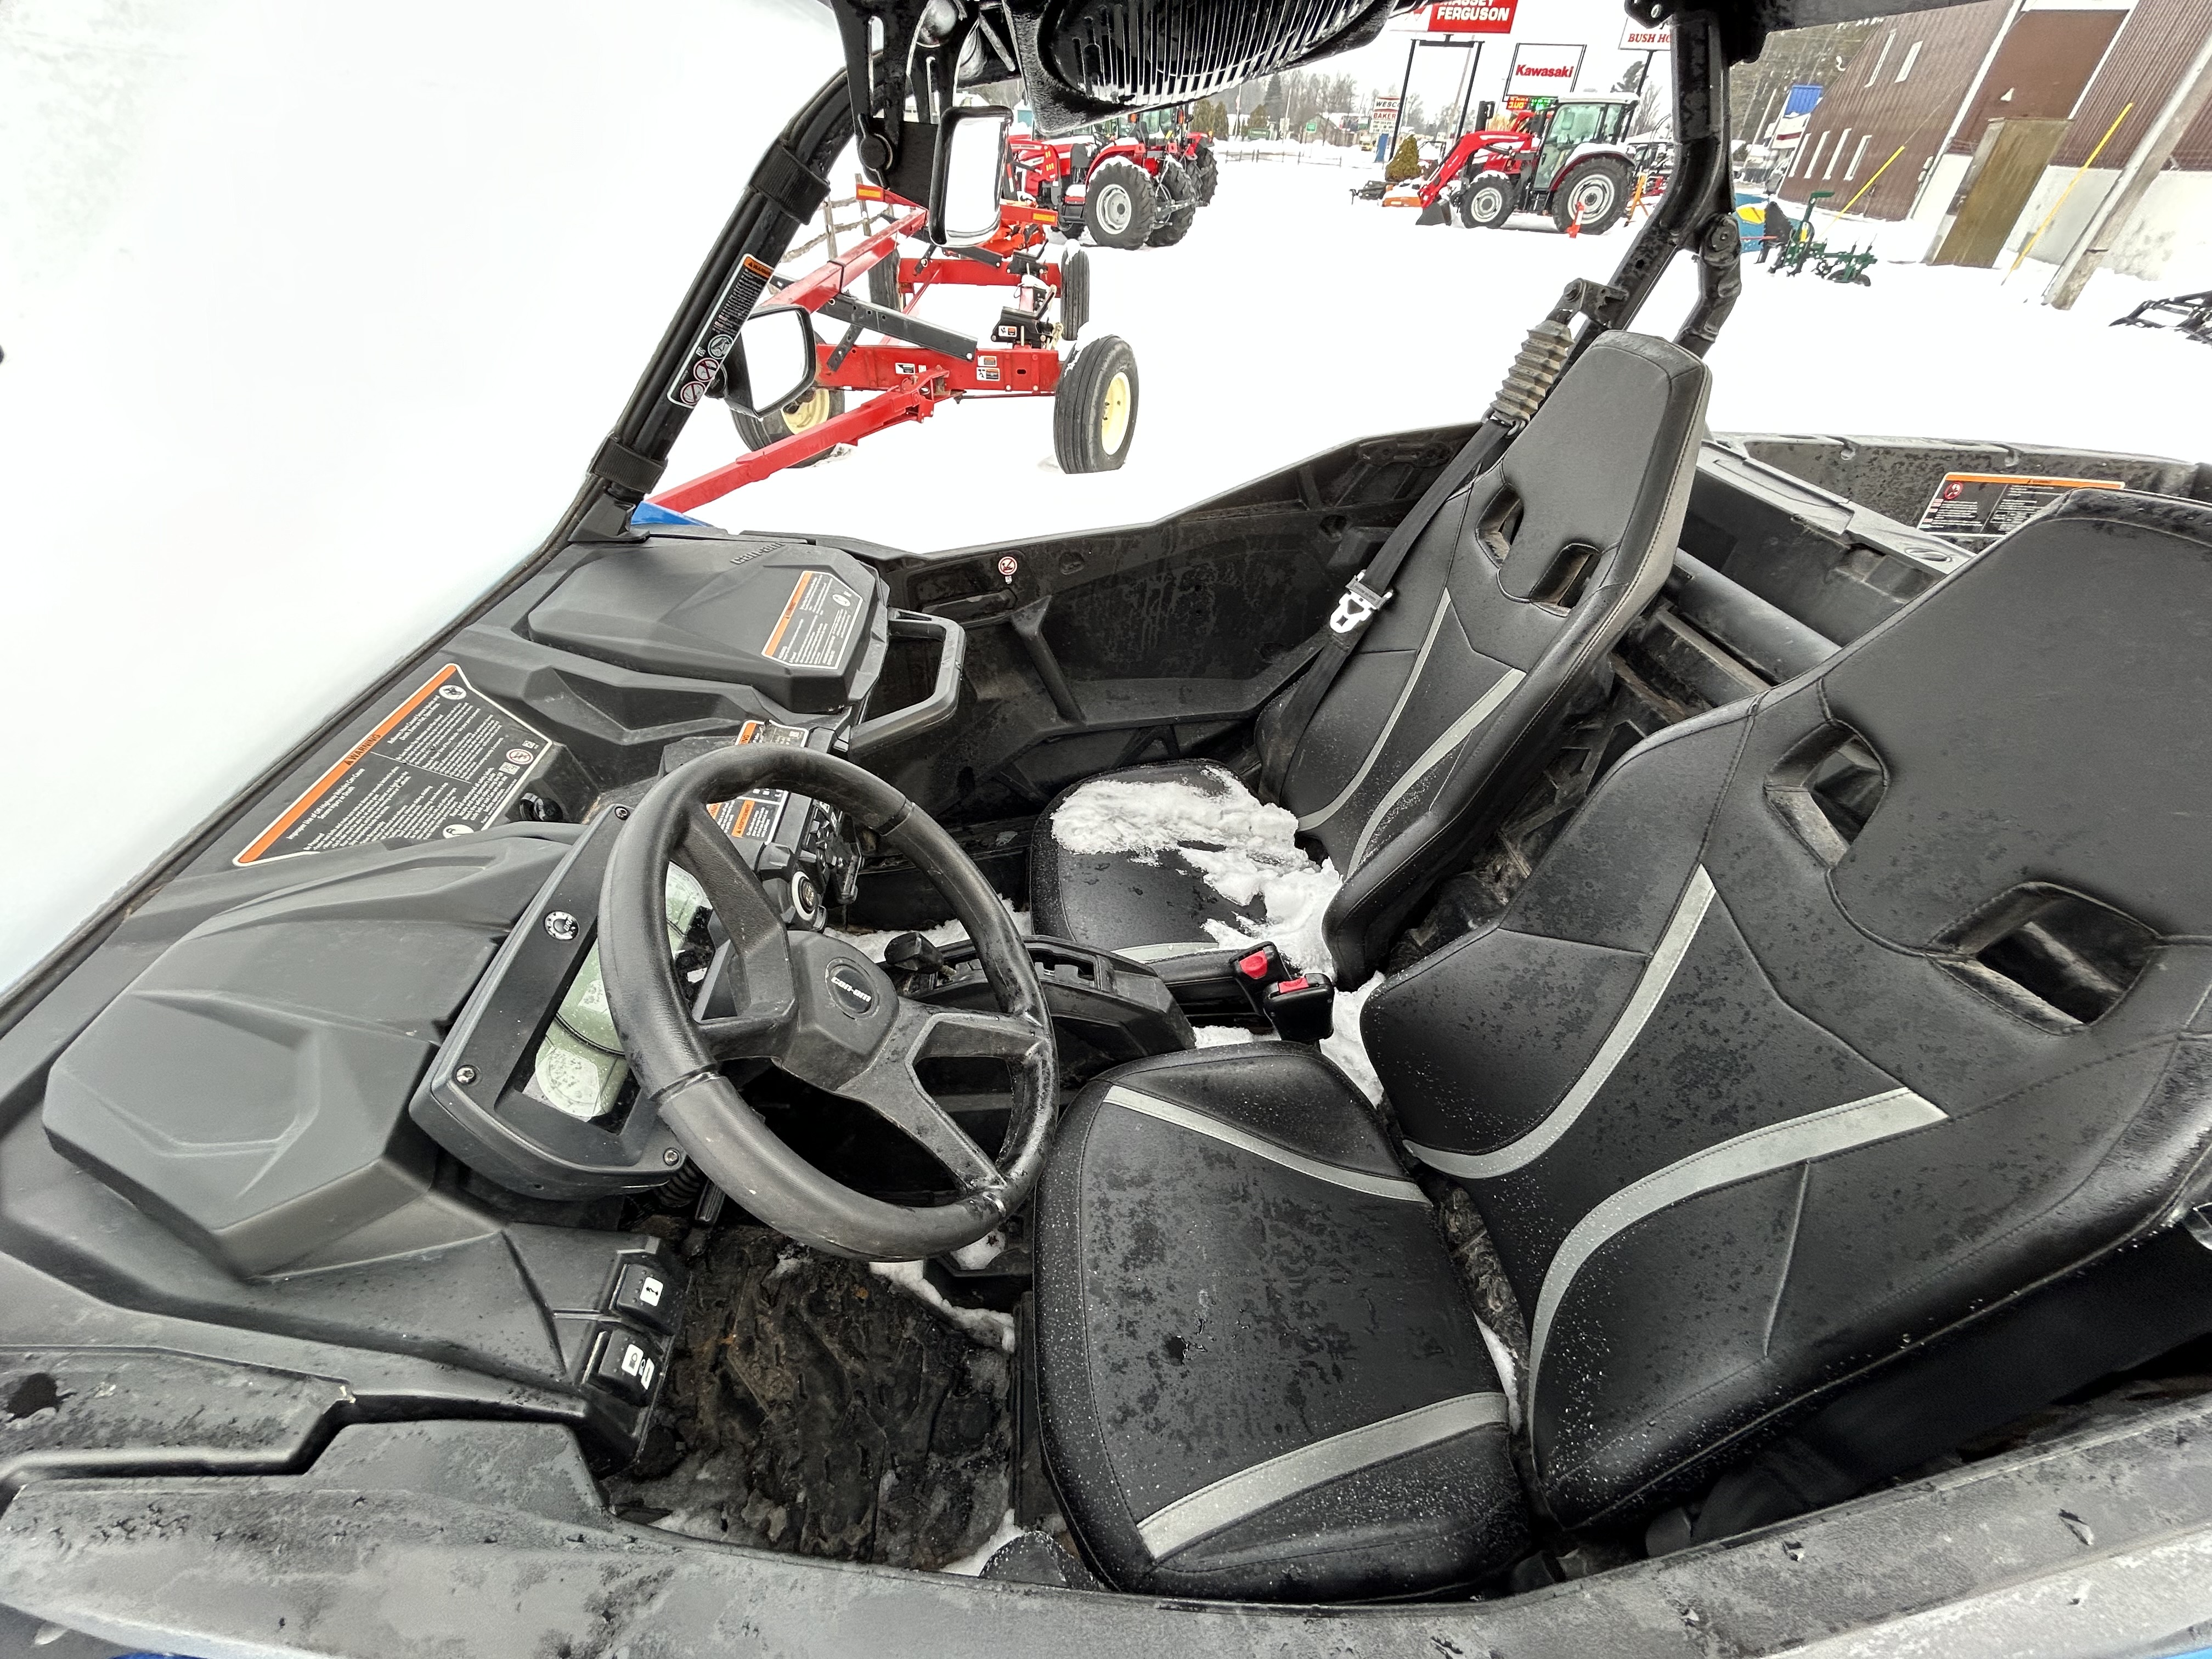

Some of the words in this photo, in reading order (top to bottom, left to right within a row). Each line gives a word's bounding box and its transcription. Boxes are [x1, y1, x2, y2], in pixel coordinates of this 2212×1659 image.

[1437, 7, 1510, 21] FERGUSON
[1628, 33, 1656, 43] BUSH
[1657, 33, 1671, 43] HO
[1515, 64, 1574, 77] Kawasaki
[730, 542, 786, 565] can-am
[347, 733, 382, 760] WARNING
[831, 977, 871, 1002] can-am
